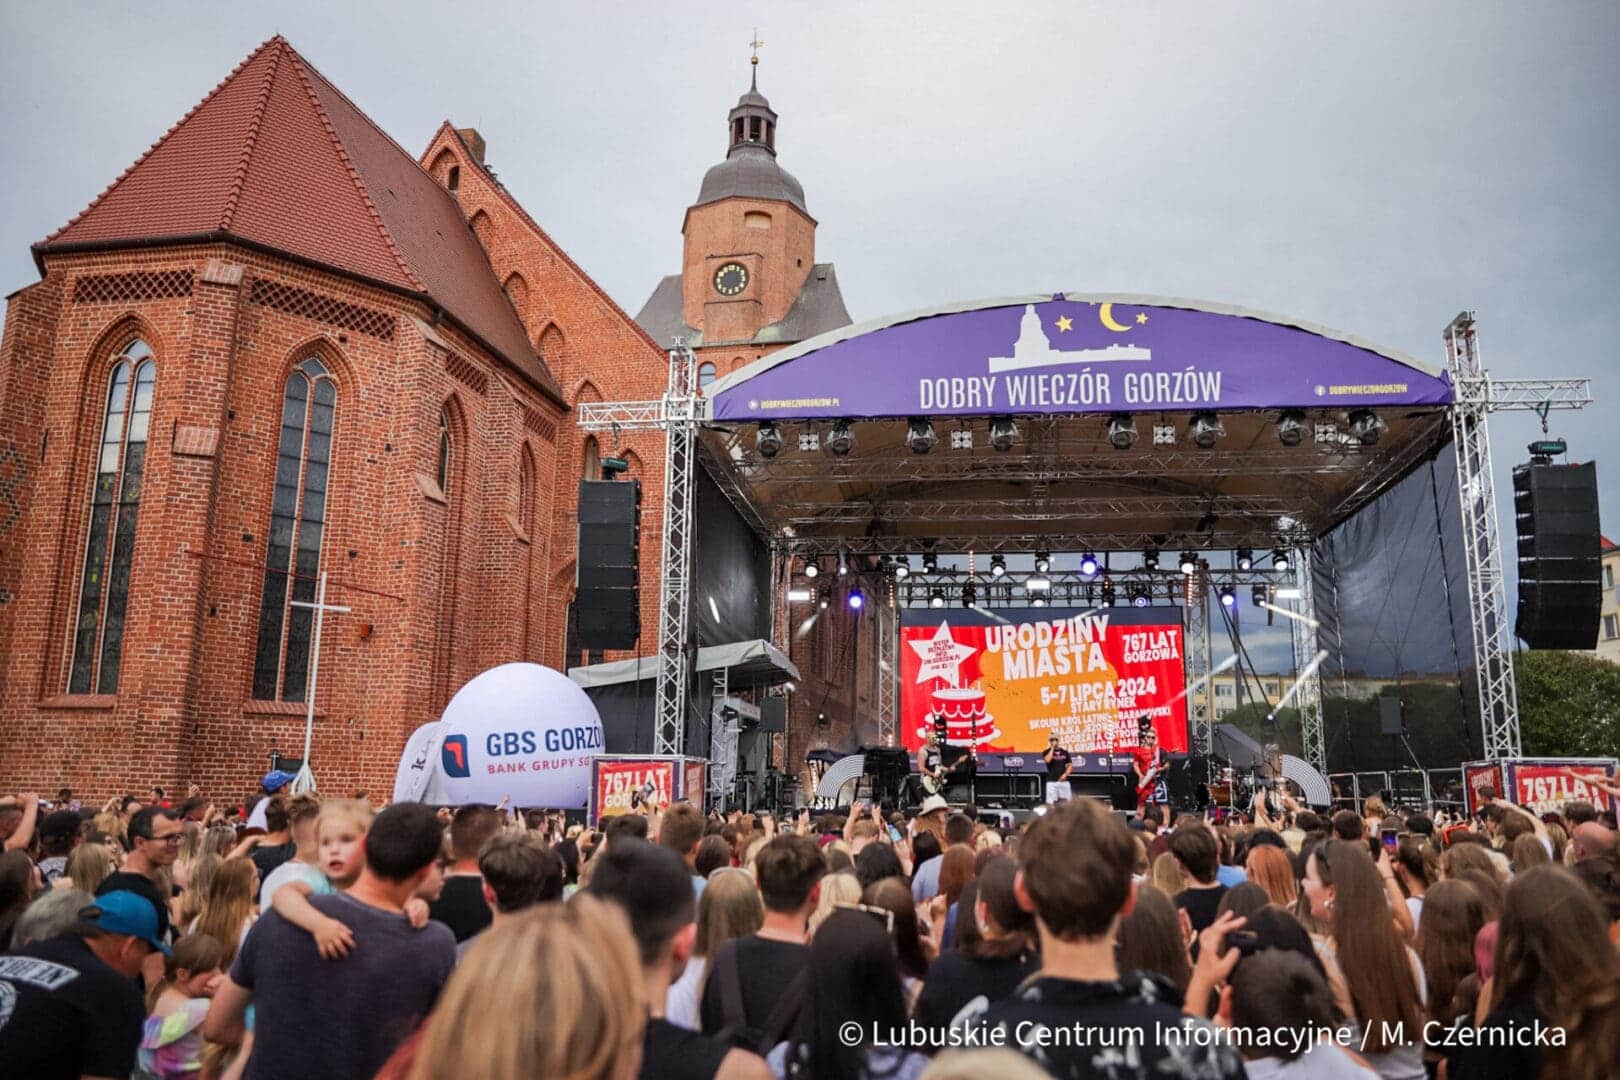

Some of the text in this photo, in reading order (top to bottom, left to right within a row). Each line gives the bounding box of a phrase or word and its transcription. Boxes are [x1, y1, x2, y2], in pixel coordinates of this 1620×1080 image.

[919, 365, 1222, 409] DOBRY WIECZÓR GORZÓW
[984, 615, 1110, 654] URODZINY
[1122, 630, 1178, 651] 767 LAT
[1003, 642, 1108, 681] MIASTA
[1123, 647, 1180, 665] GORZOWA
[1069, 681, 1116, 700] LIPCA
[1117, 676, 1157, 697] 2024
[1070, 694, 1138, 714] STARY RYNEK
[486, 719, 604, 756] GBS GORZÓ
[487, 763, 526, 774] BANK
[532, 758, 574, 771] GRUPY
[603, 771, 632, 795] 767
[1522, 776, 1557, 801] 767
